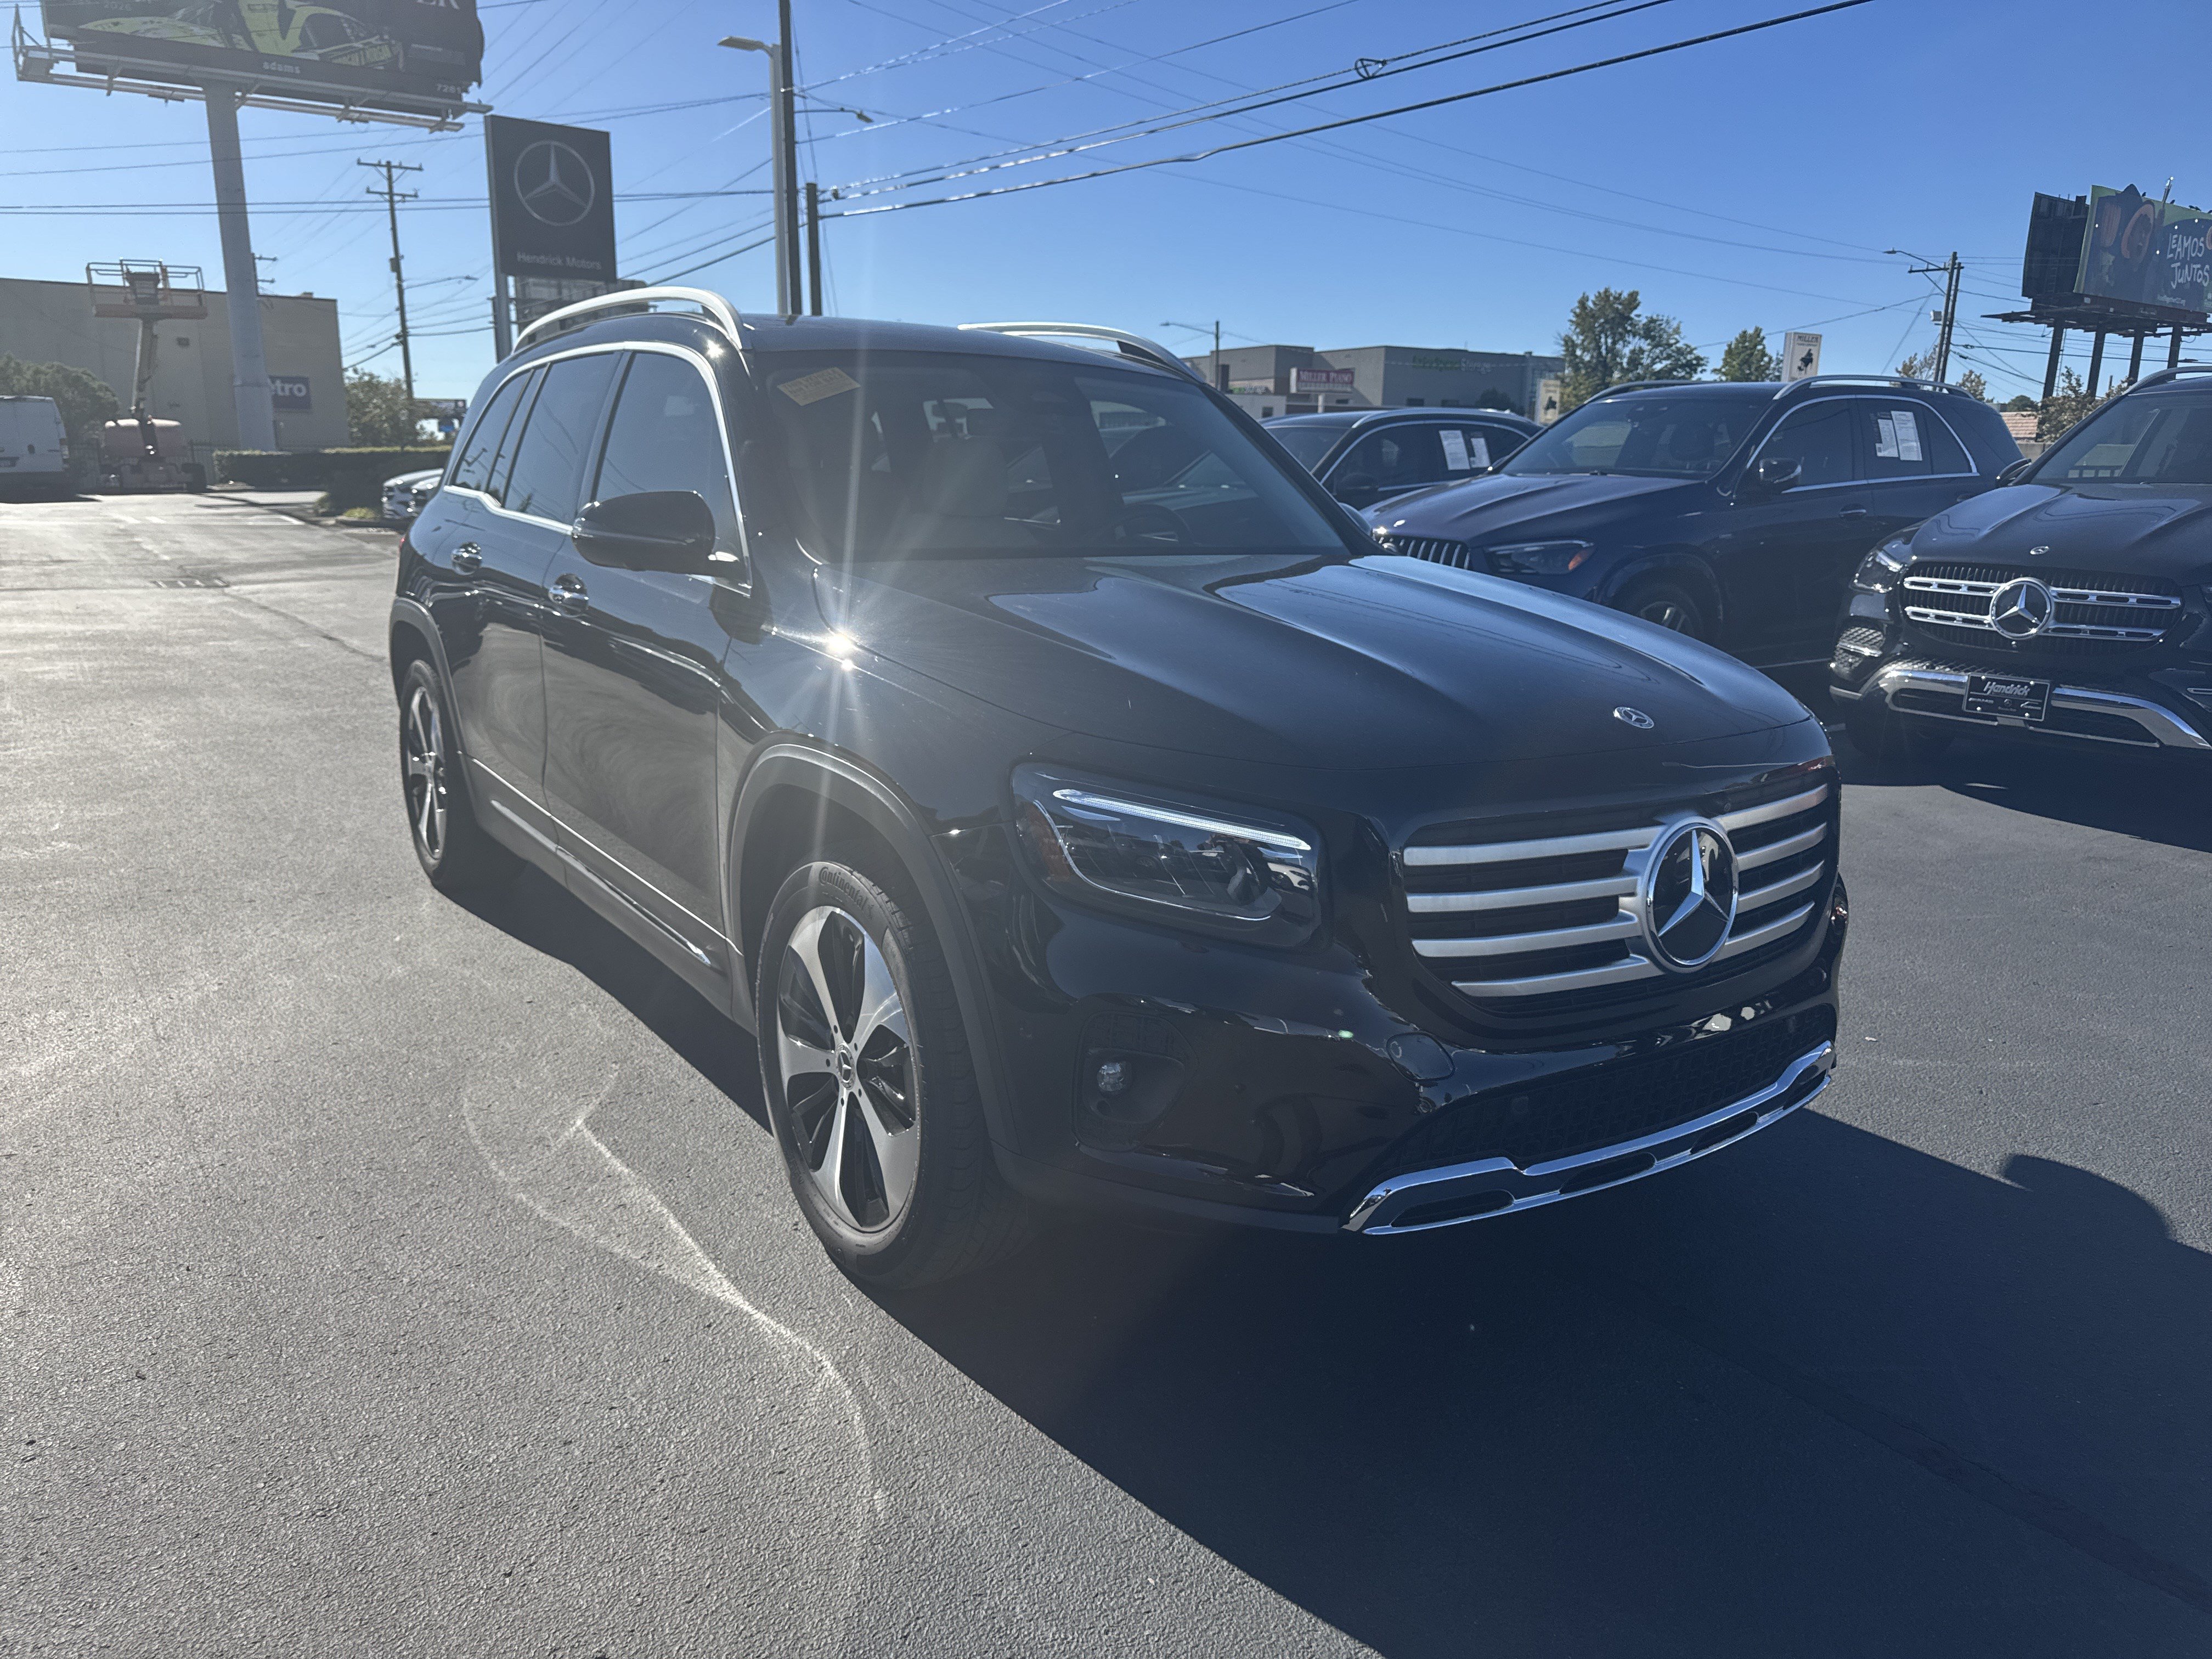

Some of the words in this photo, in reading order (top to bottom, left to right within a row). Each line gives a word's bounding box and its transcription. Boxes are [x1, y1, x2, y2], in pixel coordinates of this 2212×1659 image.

[263, 61, 301, 74] adams
[2167, 233, 2204, 261] LEAMOS
[517, 252, 563, 266] Hendrick
[566, 256, 602, 270] Motors
[1300, 371, 1327, 381] MILLER
[1329, 373, 1352, 383] PIANO
[1983, 681, 2031, 696] Hendrick
[819, 867, 868, 910] Continental
